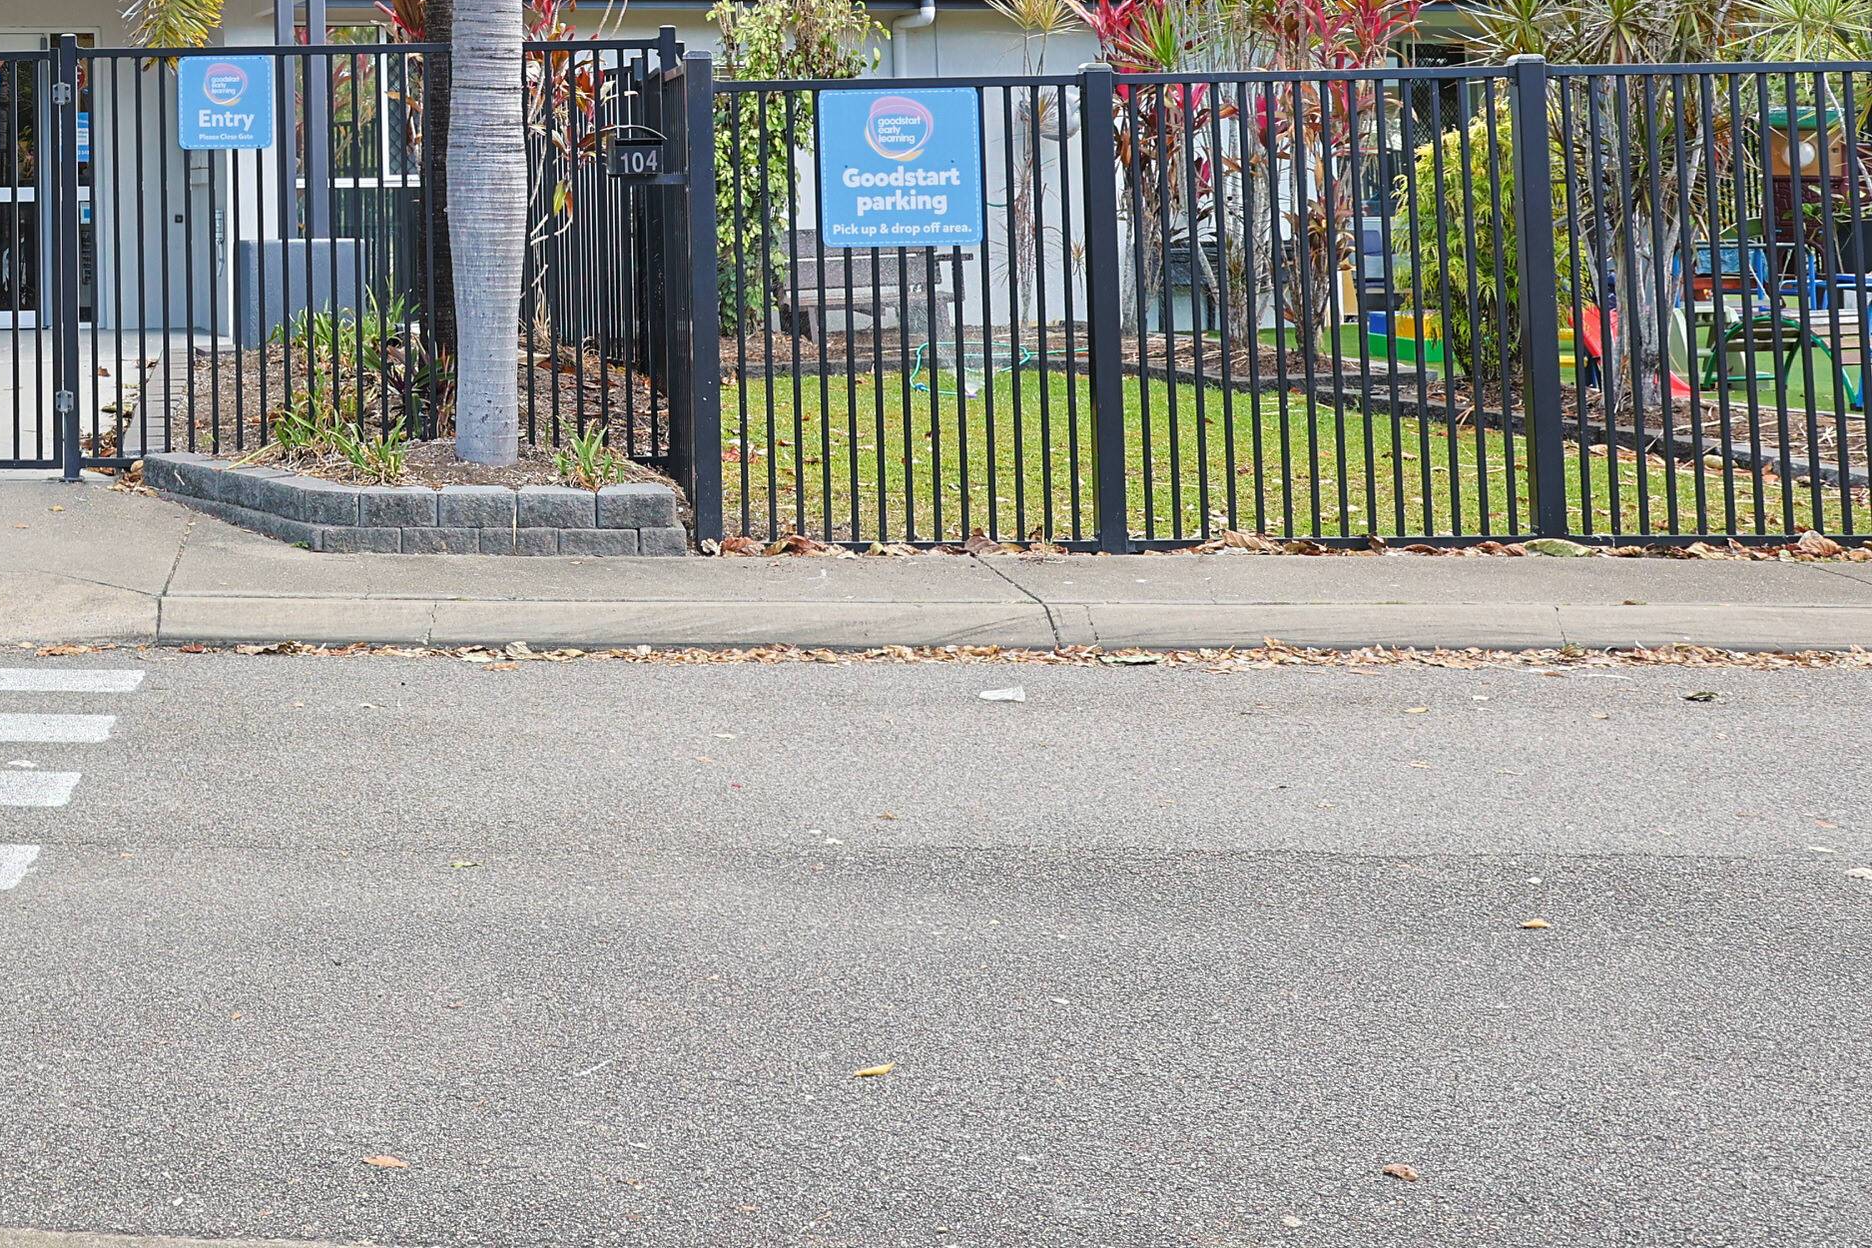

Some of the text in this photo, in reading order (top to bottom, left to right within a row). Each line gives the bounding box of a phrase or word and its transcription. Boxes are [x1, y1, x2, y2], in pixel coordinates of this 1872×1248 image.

[198, 109, 255, 132] Entry
[878, 116, 921, 126] goodstart
[878, 125, 901, 135] early
[878, 134, 915, 144] learning
[620, 150, 658, 174] 104
[842, 166, 961, 188] Goodstart
[857, 190, 948, 216] parking
[833, 222, 972, 236] Pick up & drop off area.
